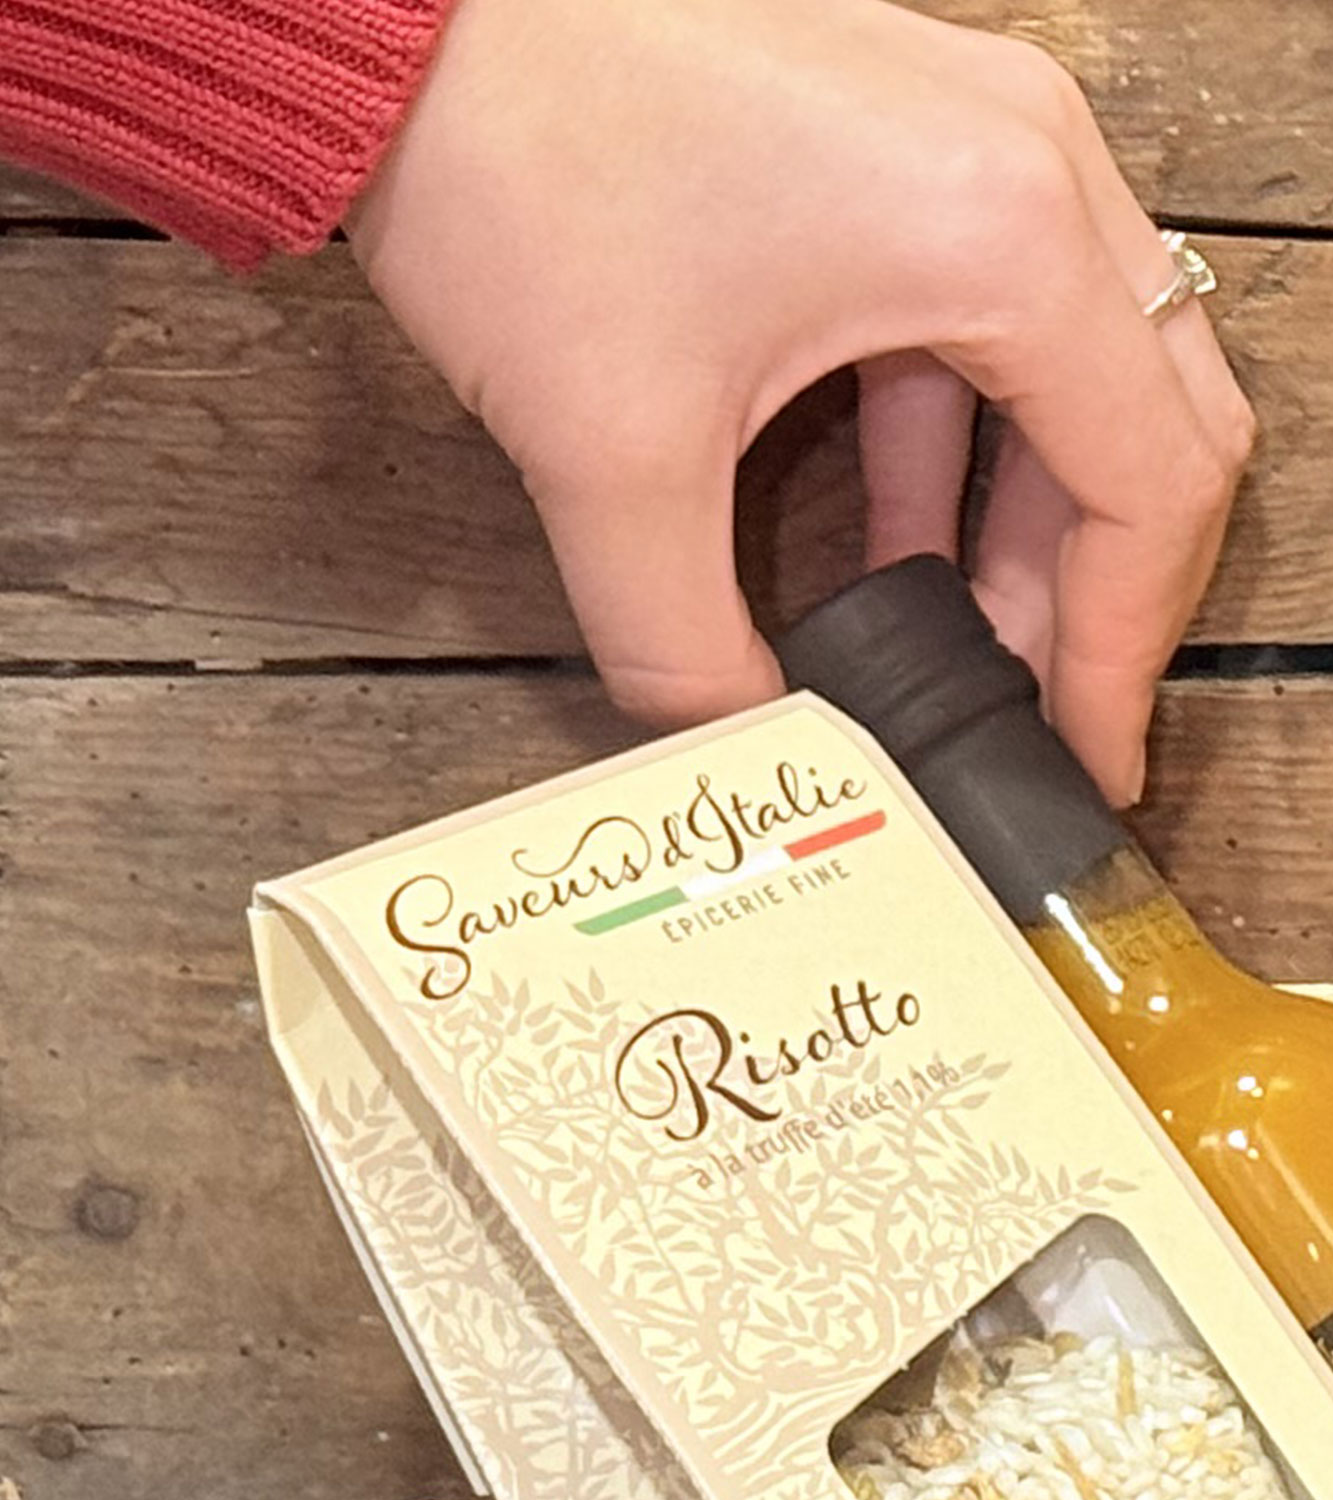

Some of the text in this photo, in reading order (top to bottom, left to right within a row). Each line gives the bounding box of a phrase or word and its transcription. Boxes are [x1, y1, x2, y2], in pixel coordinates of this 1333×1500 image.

[385, 761, 869, 1000] Saveurs d'Italie
[661, 858, 851, 943] ÉPICERIE FINE
[614, 980, 922, 1142] Risotto
[719, 1148, 740, 1178] la
[742, 1116, 823, 1171] truffe
